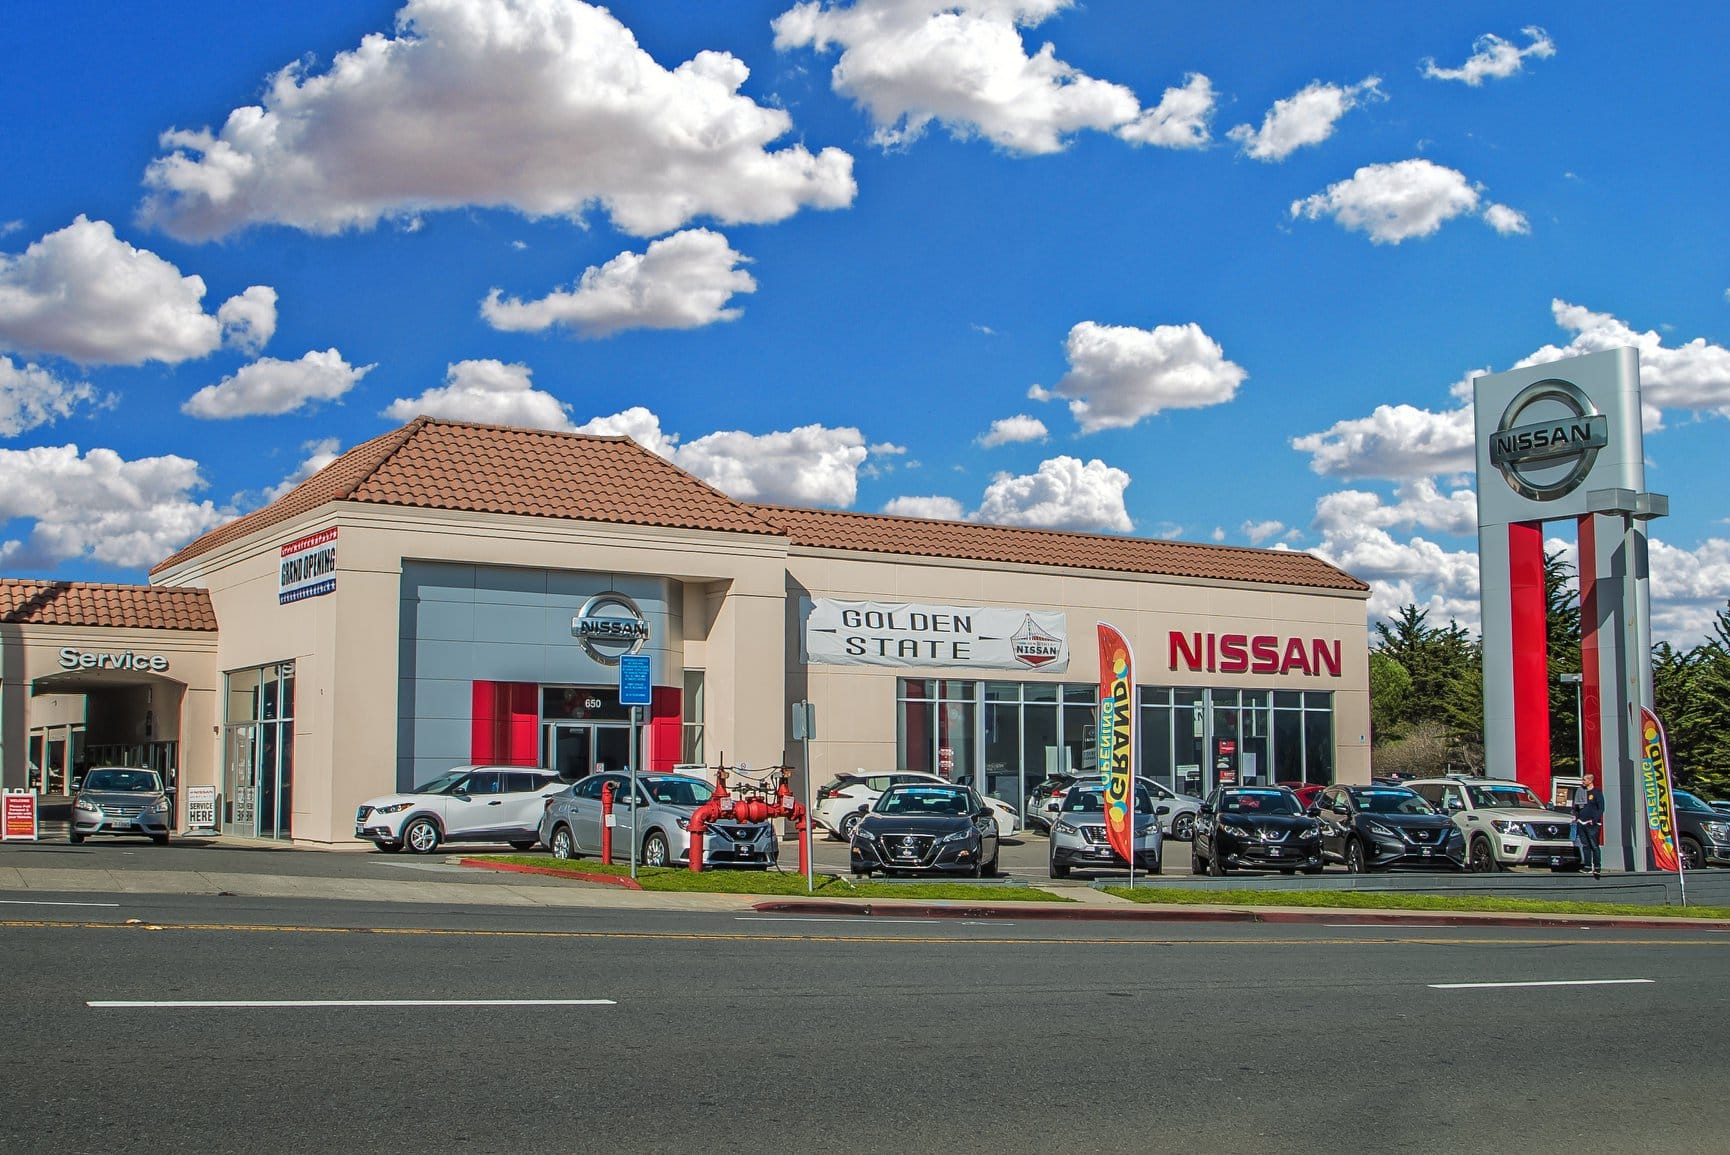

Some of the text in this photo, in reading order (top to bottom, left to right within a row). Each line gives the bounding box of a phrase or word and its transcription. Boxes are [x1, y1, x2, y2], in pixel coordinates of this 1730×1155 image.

[1497, 423, 1591, 454] NISSAN
[281, 547, 336, 587] GRAND OPENING
[580, 620, 645, 635] NISSAN
[842, 609, 972, 633] GOLDEN
[58, 647, 169, 672] Service
[846, 636, 971, 660] STATE
[1016, 645, 1057, 655] NISSAN
[1168, 631, 1342, 677] NISSAN
[585, 699, 602, 709] 650
[190, 802, 213, 810] SERVICE
[190, 810, 213, 822] HERE
